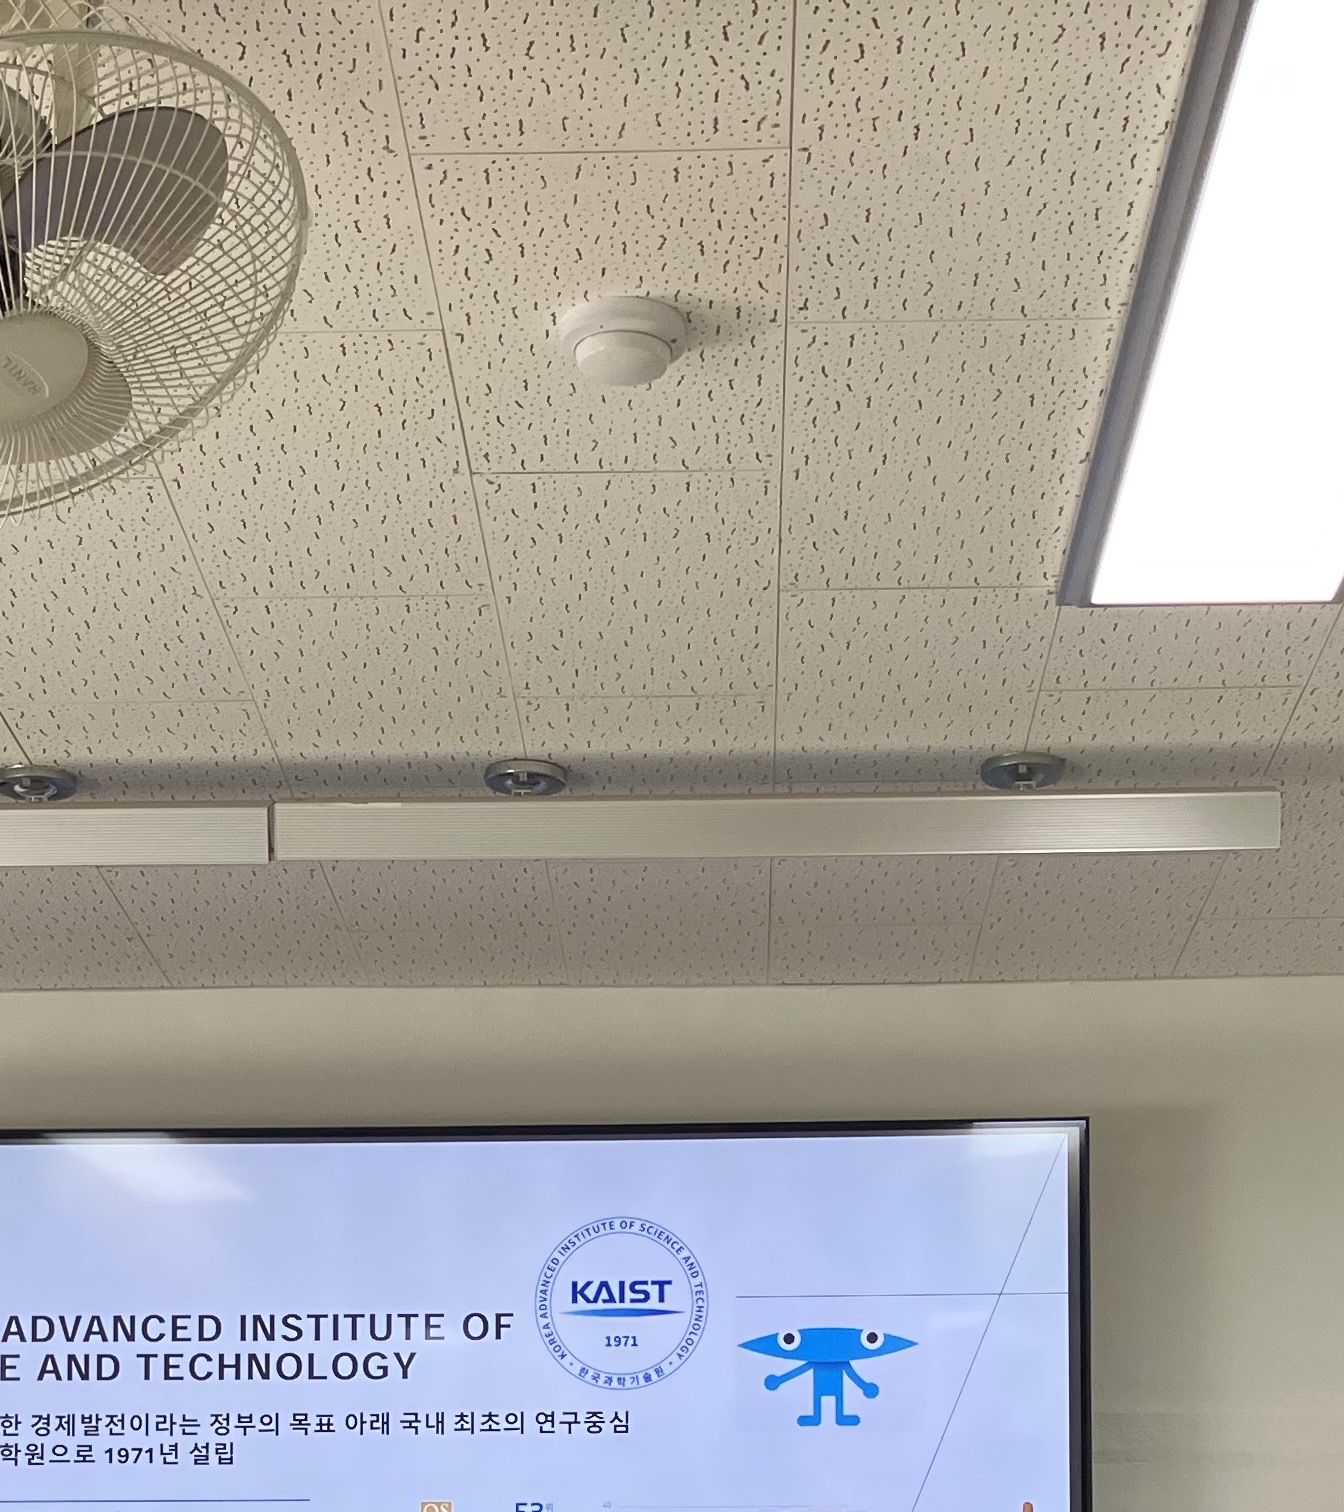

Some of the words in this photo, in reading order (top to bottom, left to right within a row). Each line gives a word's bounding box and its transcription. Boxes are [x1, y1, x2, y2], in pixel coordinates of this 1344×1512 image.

[558, 1221, 615, 1257] INSTITUTE
[619, 1220, 635, 1230] OF
[639, 1223, 684, 1255] SCIENCE
[683, 1256, 699, 1279] AND
[538, 1257, 560, 1319] ADVANCED
[571, 1280, 672, 1304] KAIST
[1, 1314, 222, 1343] ADVANCED
[240, 1313, 445, 1342] INSTITUTE
[462, 1312, 514, 1341] OF
[676, 1282, 704, 1360] TECHNOLOGY
[542, 1323, 567, 1360] KOREA
[605, 1336, 638, 1347] 1971
[36, 1353, 120, 1382] AND
[137, 1351, 417, 1382] TECHNOLOGY
[31, 1413, 201, 1438] 경제발전이라는
[210, 1412, 280, 1437] 정부의
[289, 1412, 336, 1437] 목표
[345, 1411, 390, 1436] 아래
[399, 1411, 446, 1436] 국내
[453, 1411, 525, 1435] 최초의
[534, 1410, 631, 1435] 연구중심
[104, 1442, 180, 1466] 1971년
[189, 1442, 235, 1466] 설립
